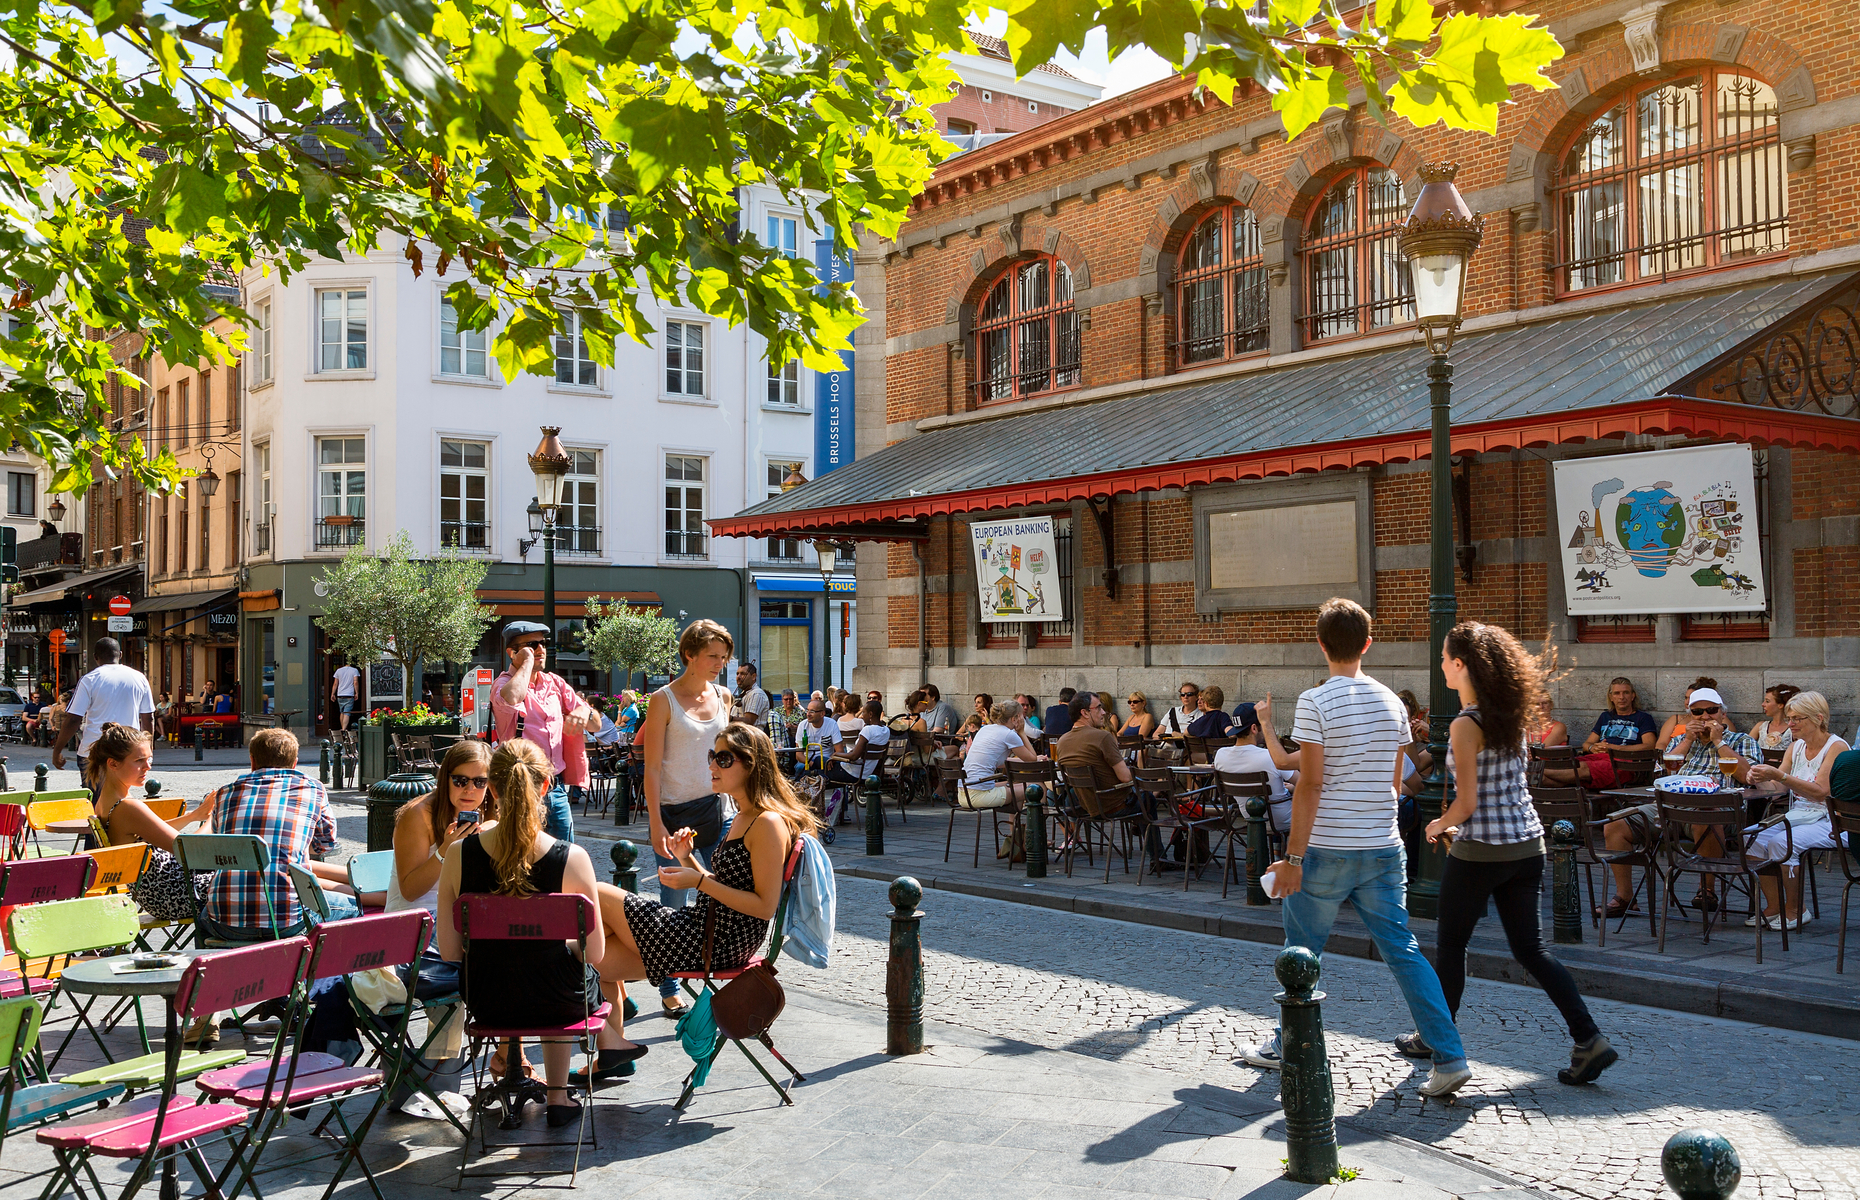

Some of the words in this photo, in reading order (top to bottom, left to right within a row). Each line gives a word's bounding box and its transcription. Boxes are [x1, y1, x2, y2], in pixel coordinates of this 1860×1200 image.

[830, 406, 839, 464] BRUSSELS
[975, 525, 1013, 539] EUROPEAN
[1015, 522, 1049, 536] BANKING
[1030, 550, 1043, 562] HELP!
[829, 583, 856, 591] TOUC
[214, 855, 239, 867] ZEBRA
[100, 871, 122, 884] ZEBRA
[30, 884, 57, 899] ZEBRA
[508, 923, 543, 937] ZEBRA
[352, 949, 385, 969] ZEBRA
[232, 978, 264, 1005] ZEBRA
